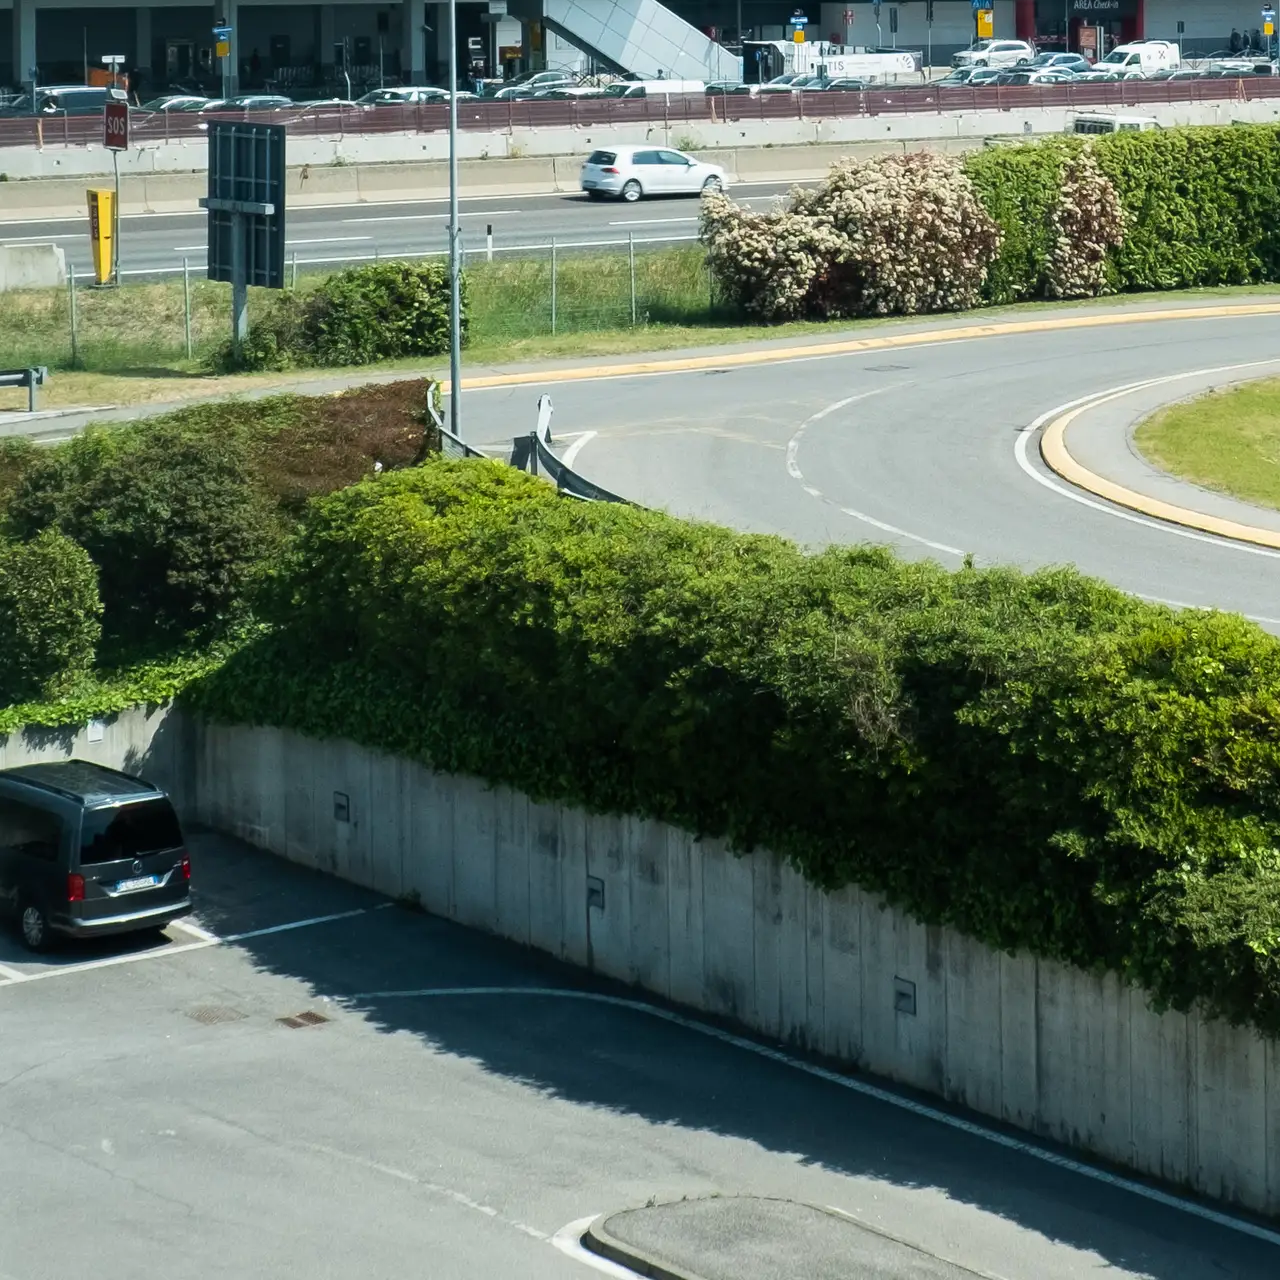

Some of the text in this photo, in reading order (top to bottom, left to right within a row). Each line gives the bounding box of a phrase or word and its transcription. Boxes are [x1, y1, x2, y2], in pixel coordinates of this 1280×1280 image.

[1074, 0, 1119, 9] AREA Check-in
[107, 116, 125, 136] SOS
